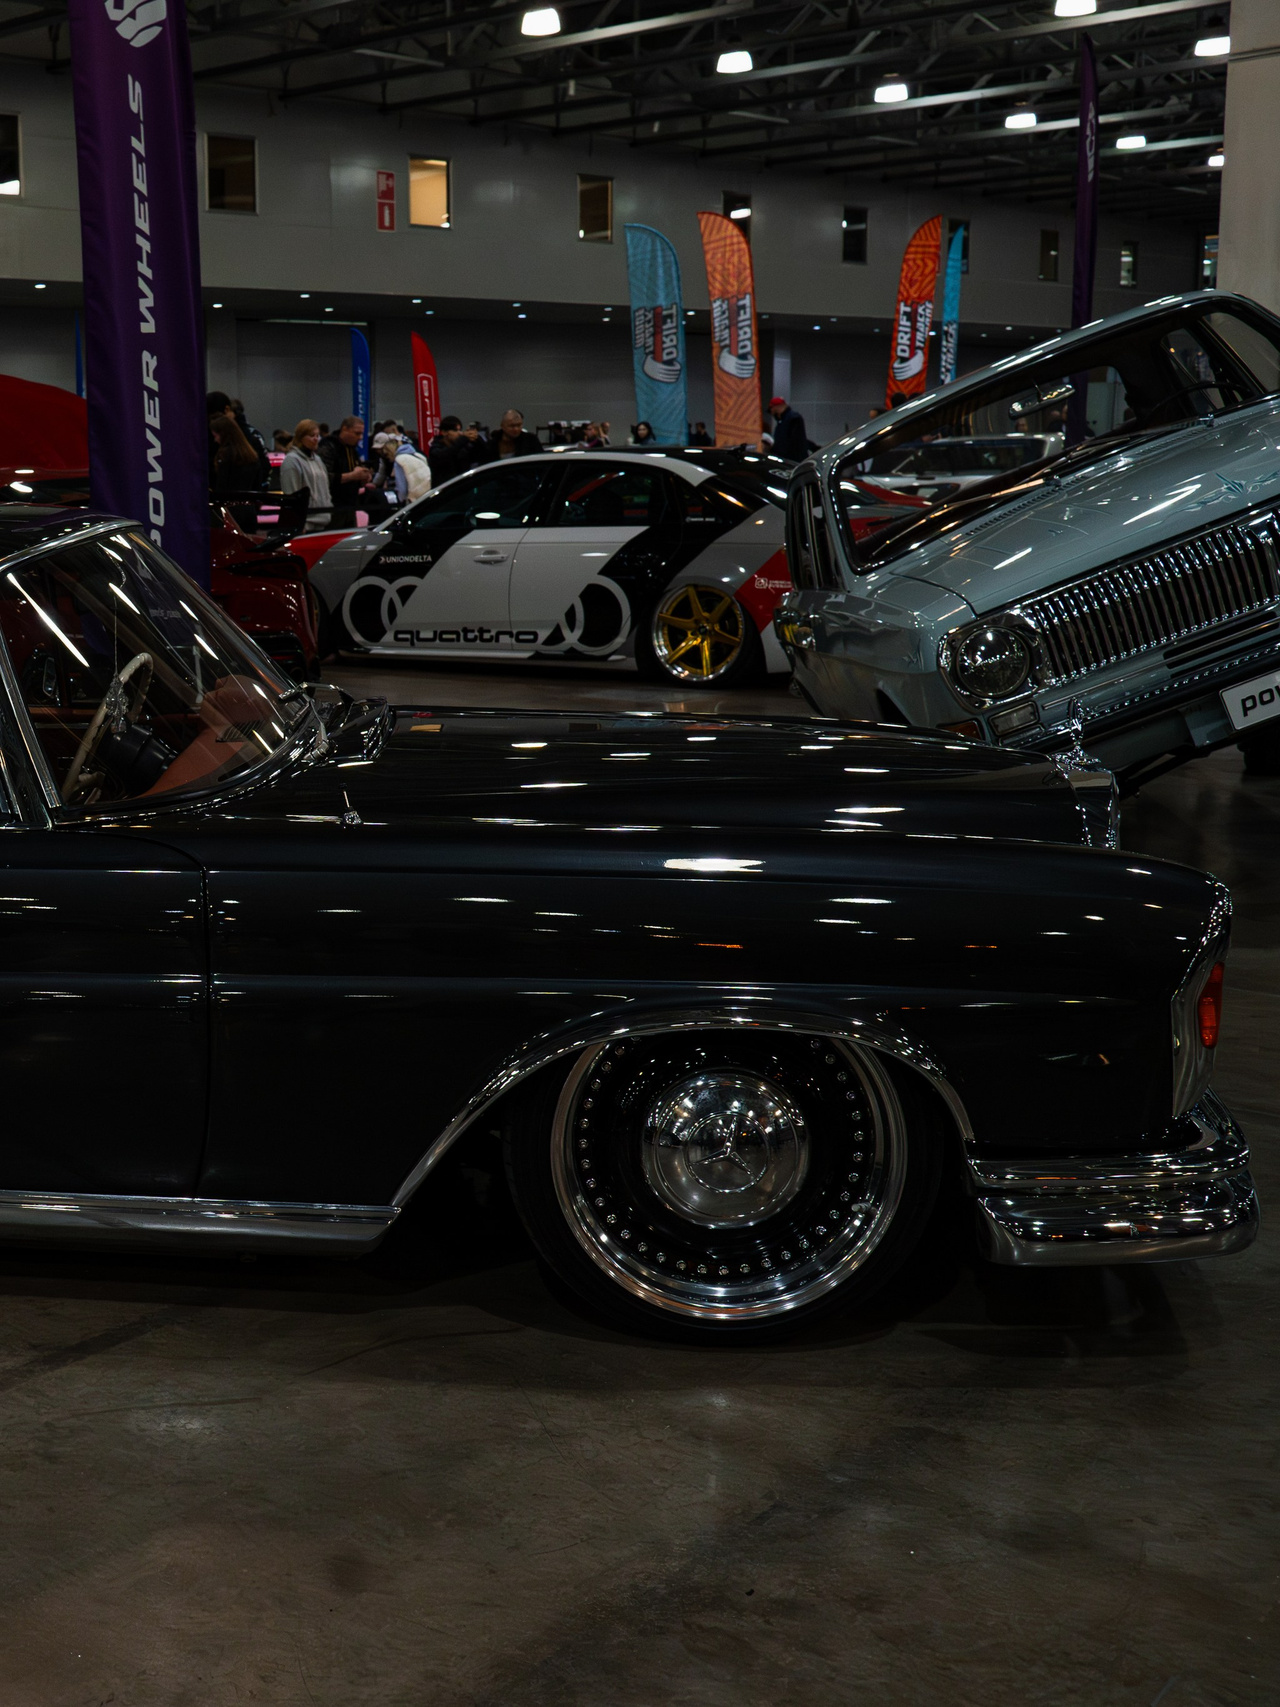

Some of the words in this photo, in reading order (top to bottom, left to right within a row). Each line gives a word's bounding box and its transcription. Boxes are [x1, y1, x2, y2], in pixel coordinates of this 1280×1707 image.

[127, 73, 156, 333] WHEELS
[896, 301, 912, 359] DRIFT
[915, 302, 926, 348] TRACK
[141, 350, 165, 549] POWER
[385, 555, 432, 564] UNIONDELTA
[394, 627, 538, 646] quattro
[1241, 685, 1280, 717] po
